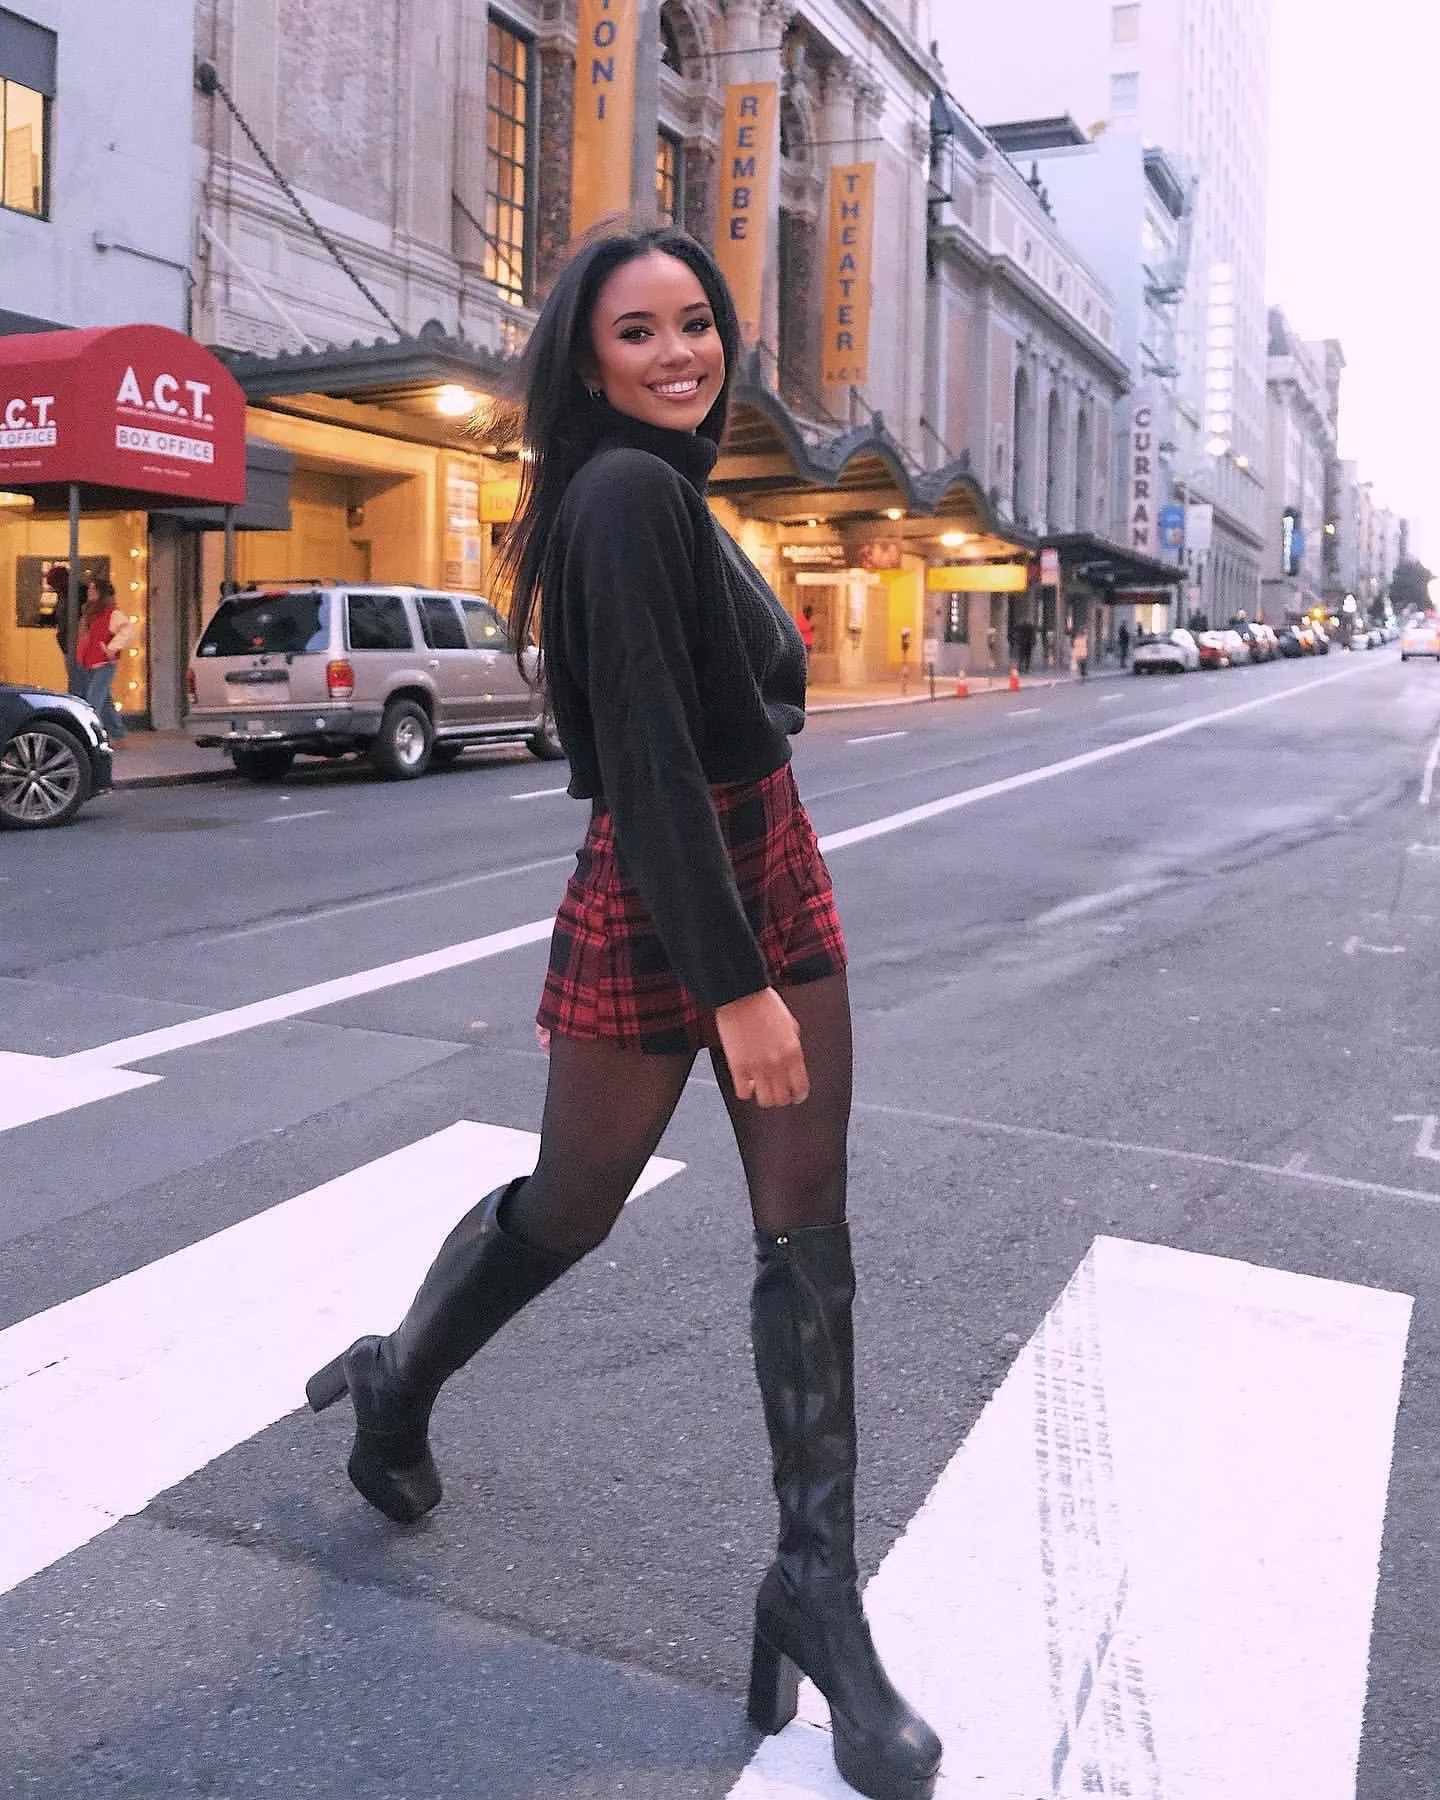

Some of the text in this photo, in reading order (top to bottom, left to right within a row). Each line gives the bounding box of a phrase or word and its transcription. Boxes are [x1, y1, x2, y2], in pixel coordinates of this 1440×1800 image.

[729, 95, 759, 241] REMBE
[836, 174, 860, 351] THEATER
[7, 429, 54, 445] OFFICE
[116, 365, 214, 422] A.C.T.
[119, 429, 211, 460] BOX OFFICE
[1132, 408, 1151, 546] CURRAN
